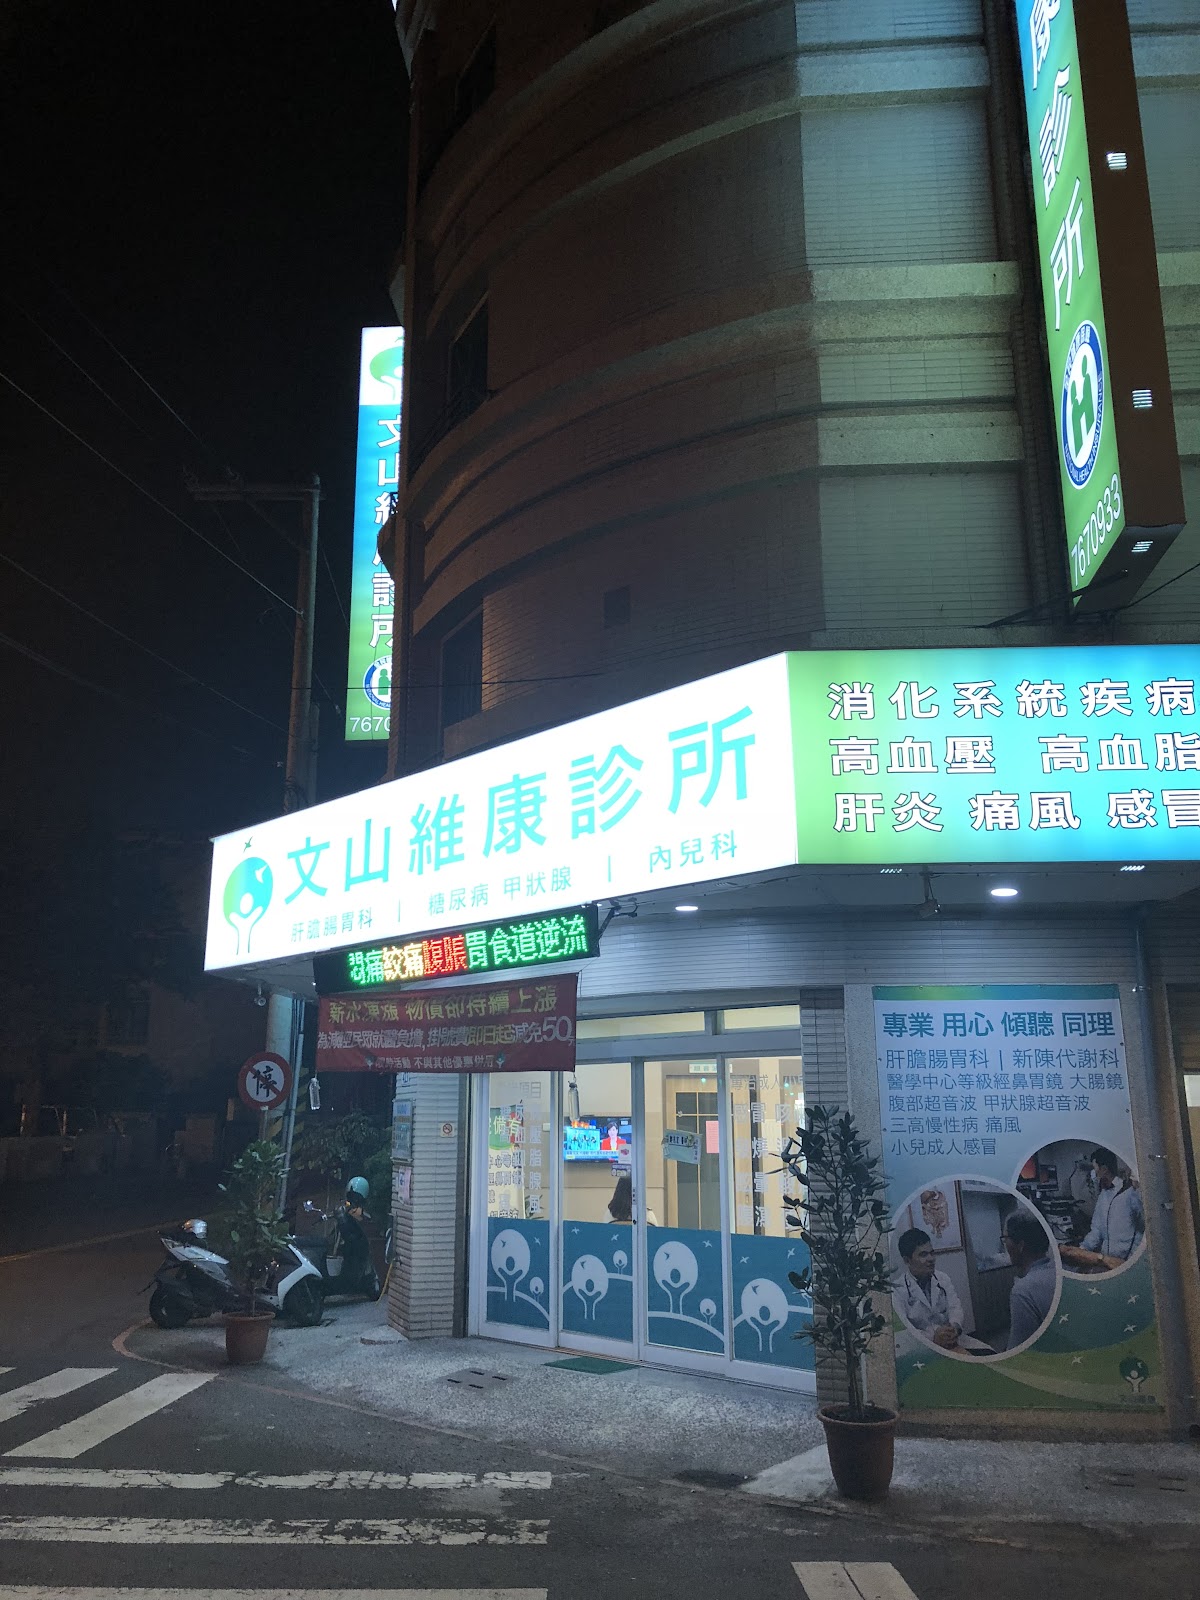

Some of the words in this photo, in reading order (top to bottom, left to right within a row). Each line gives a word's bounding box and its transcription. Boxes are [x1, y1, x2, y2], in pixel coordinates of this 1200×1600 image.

[1070, 473, 1121, 588] 7670933
[828, 677, 1196, 721] 消化系統疾病
[828, 736, 997, 777] 高血壓
[1038, 732, 1200, 774] 高血脂
[284, 705, 756, 905] 文山維康診所
[833, 791, 945, 833] 肝炎
[968, 789, 1082, 832] 痛風
[1107, 788, 1200, 829] 感冒
[290, 906, 373, 943] 肝膽腸胃科
[428, 883, 489, 917] 糖尿病
[503, 865, 573, 900] 甲狀腺
[882, 1012, 935, 1038] 專業
[942, 1012, 994, 1038] 用心
[1000, 1011, 1055, 1038] 傾聽
[1061, 1011, 1116, 1038] 同理
[885, 1048, 990, 1070] 肝膽腸胃科
[1012, 1047, 1120, 1070] 新陳代謝科
[252, 1065, 277, 1098] 停
[886, 1072, 1064, 1092] 醫學中心等級經鼻胃鏡
[1069, 1072, 1125, 1091] 大腸鏡
[888, 1094, 978, 1113] 腹部超音波
[983, 1094, 1092, 1113] 甲狀腺超音波
[488, 1115, 522, 1137] 備有
[890, 1116, 980, 1135] 三高慢性病
[985, 1116, 1023, 1135] 痛風
[891, 1137, 998, 1157] 小兒成人感冒
